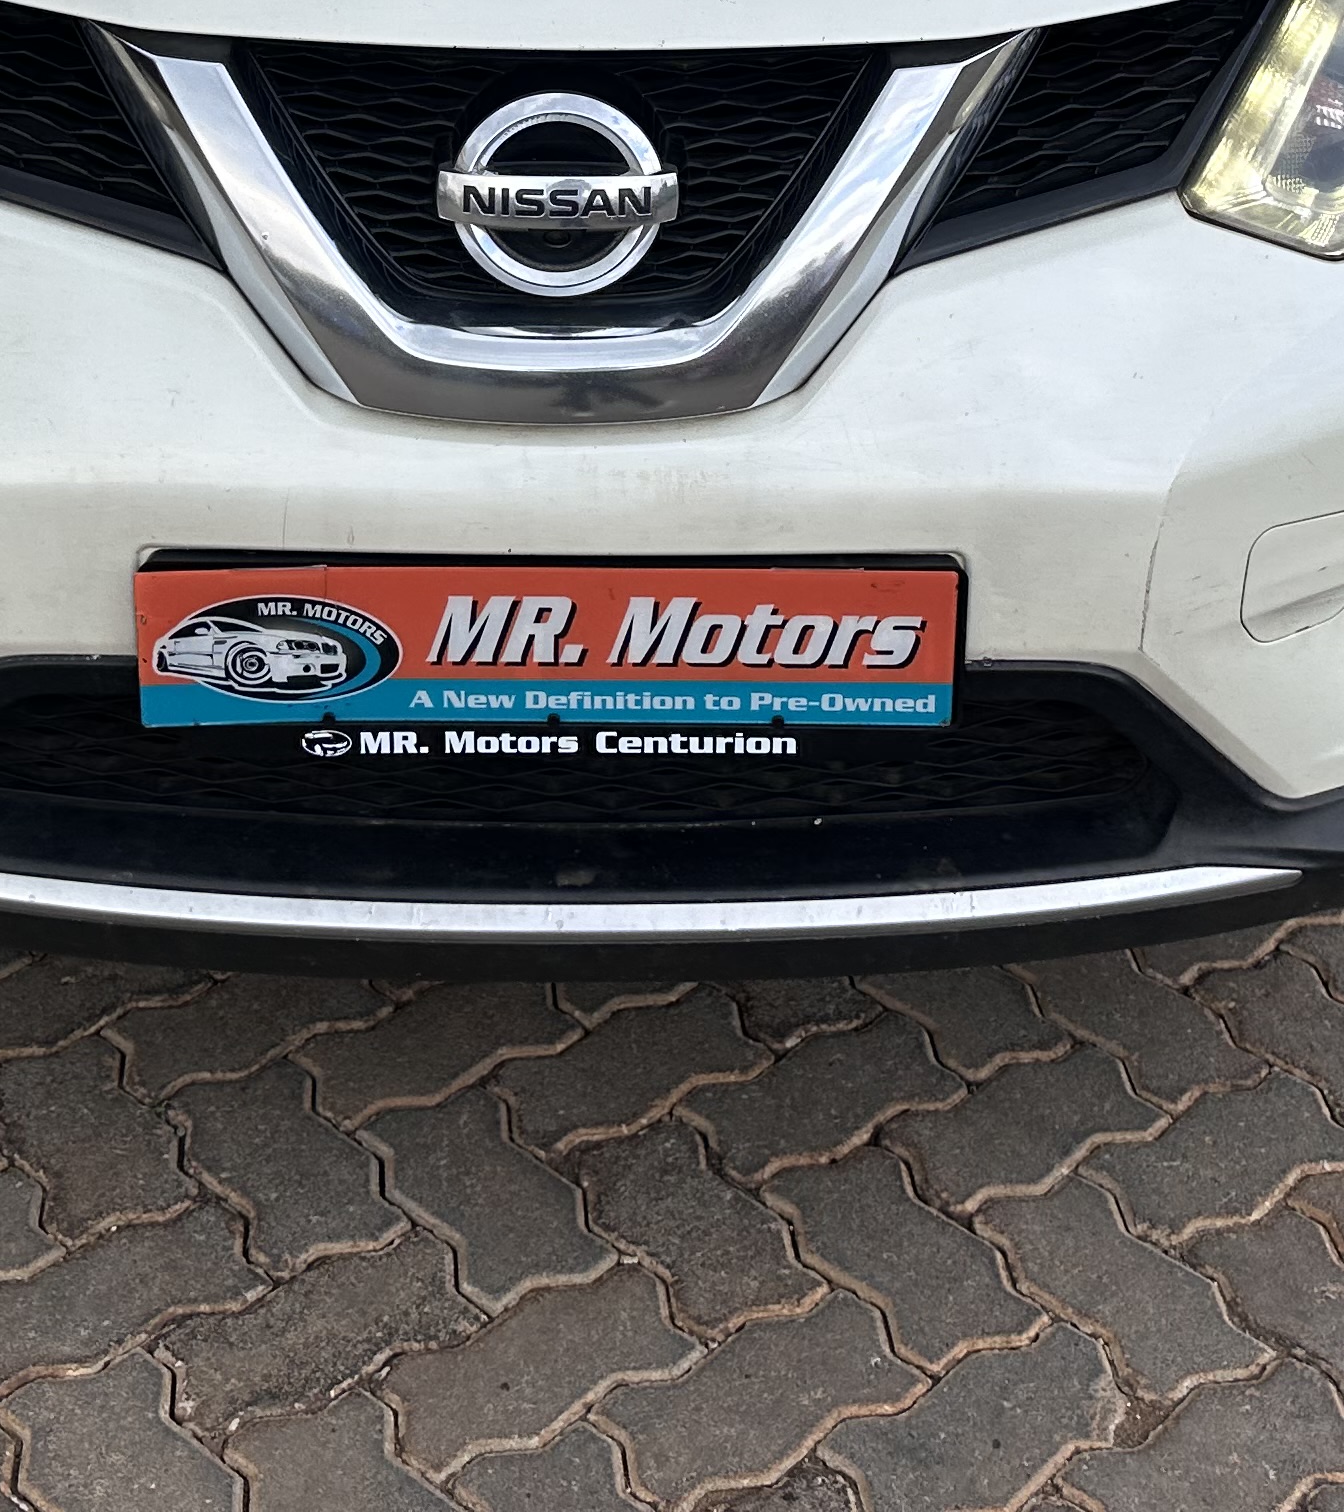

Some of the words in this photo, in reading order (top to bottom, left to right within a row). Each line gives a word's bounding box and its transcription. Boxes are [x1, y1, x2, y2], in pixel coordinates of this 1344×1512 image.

[461, 184, 653, 219] NISSAN
[257, 601, 298, 617] MR.
[303, 603, 388, 645] MOTORS
[427, 595, 587, 668] MR.
[608, 595, 924, 670] Motors
[409, 690, 434, 709] A
[443, 690, 516, 710] New
[524, 691, 696, 711] Definition
[704, 692, 742, 711] to
[750, 692, 937, 714] Pre-Owned
[359, 731, 429, 755] MR.
[444, 730, 579, 755] Motors
[595, 731, 798, 755] Centurion
